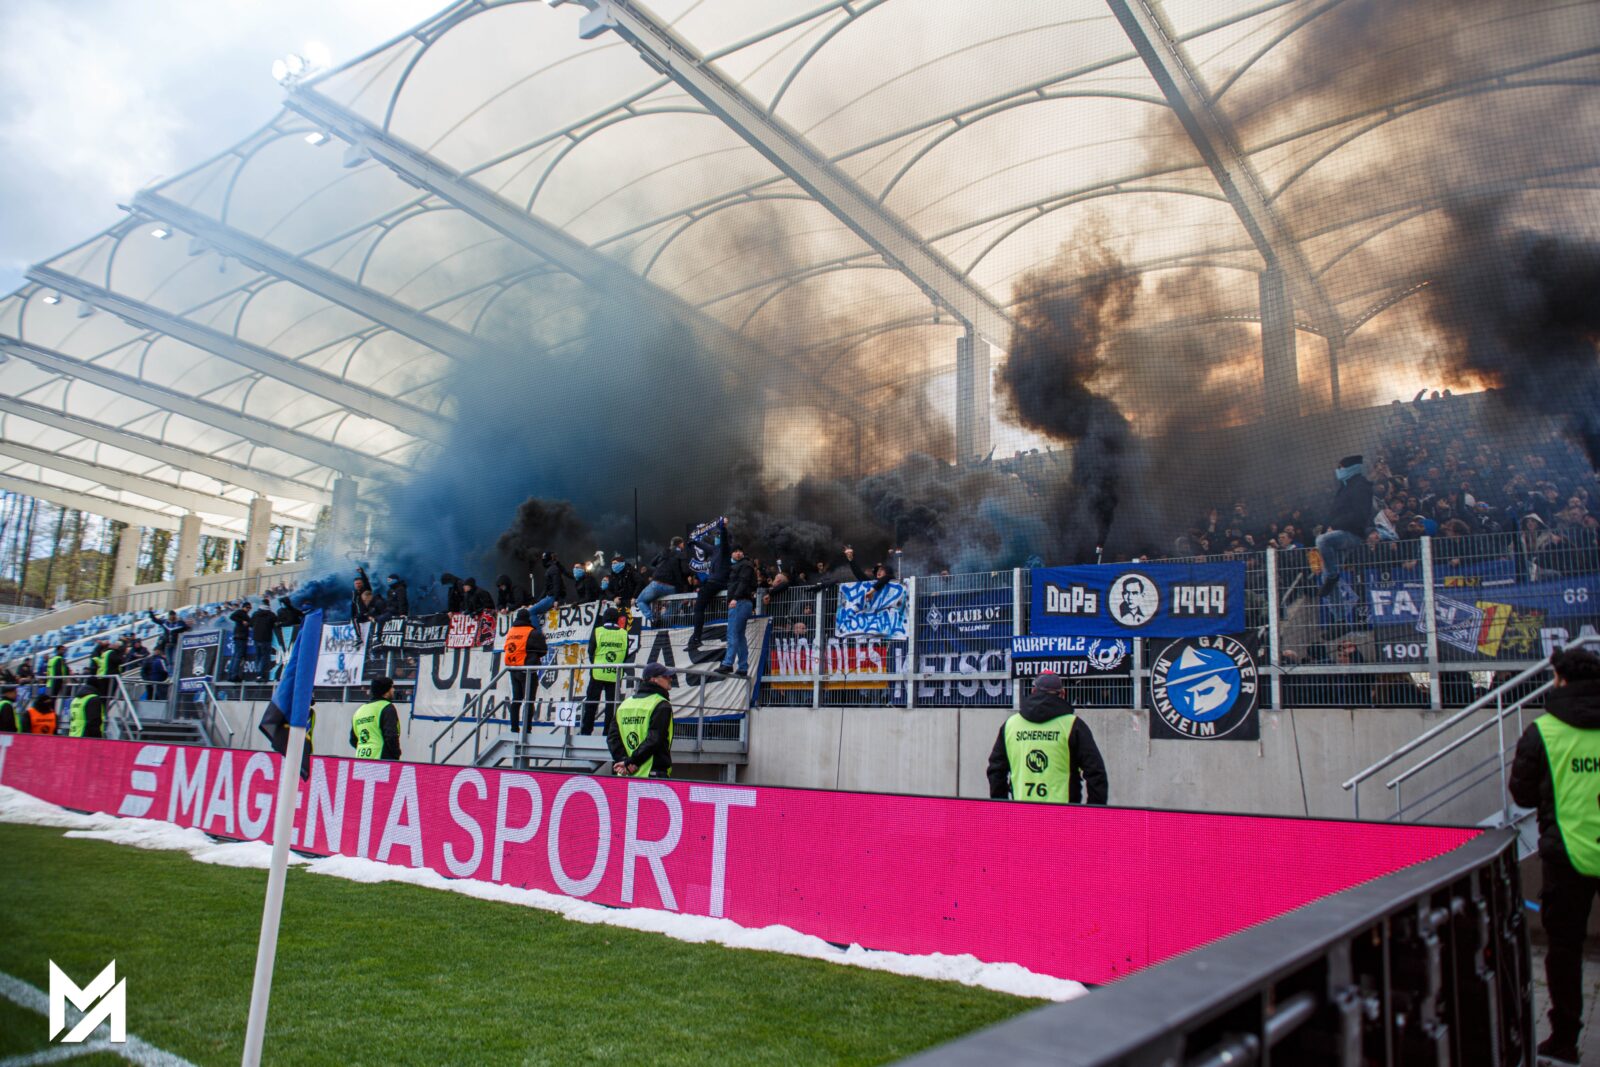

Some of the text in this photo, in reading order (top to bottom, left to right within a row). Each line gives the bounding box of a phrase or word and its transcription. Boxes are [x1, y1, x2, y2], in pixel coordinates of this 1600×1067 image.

[1047, 585, 1225, 614] DoPa 1999
[1563, 588, 1588, 604] 68
[948, 607, 1000, 624] CLUB 07
[1013, 636, 1085, 653] KURPFALZ
[1015, 660, 1088, 675] PATRIOTEN
[1199, 636, 1255, 694] GAUNER
[1154, 658, 1216, 736] MANNHEIM
[559, 706, 574, 722] C2
[1016, 730, 1060, 742] SICHERHEIT
[1025, 782, 1048, 798] 76
[443, 766, 757, 918] SPORT
